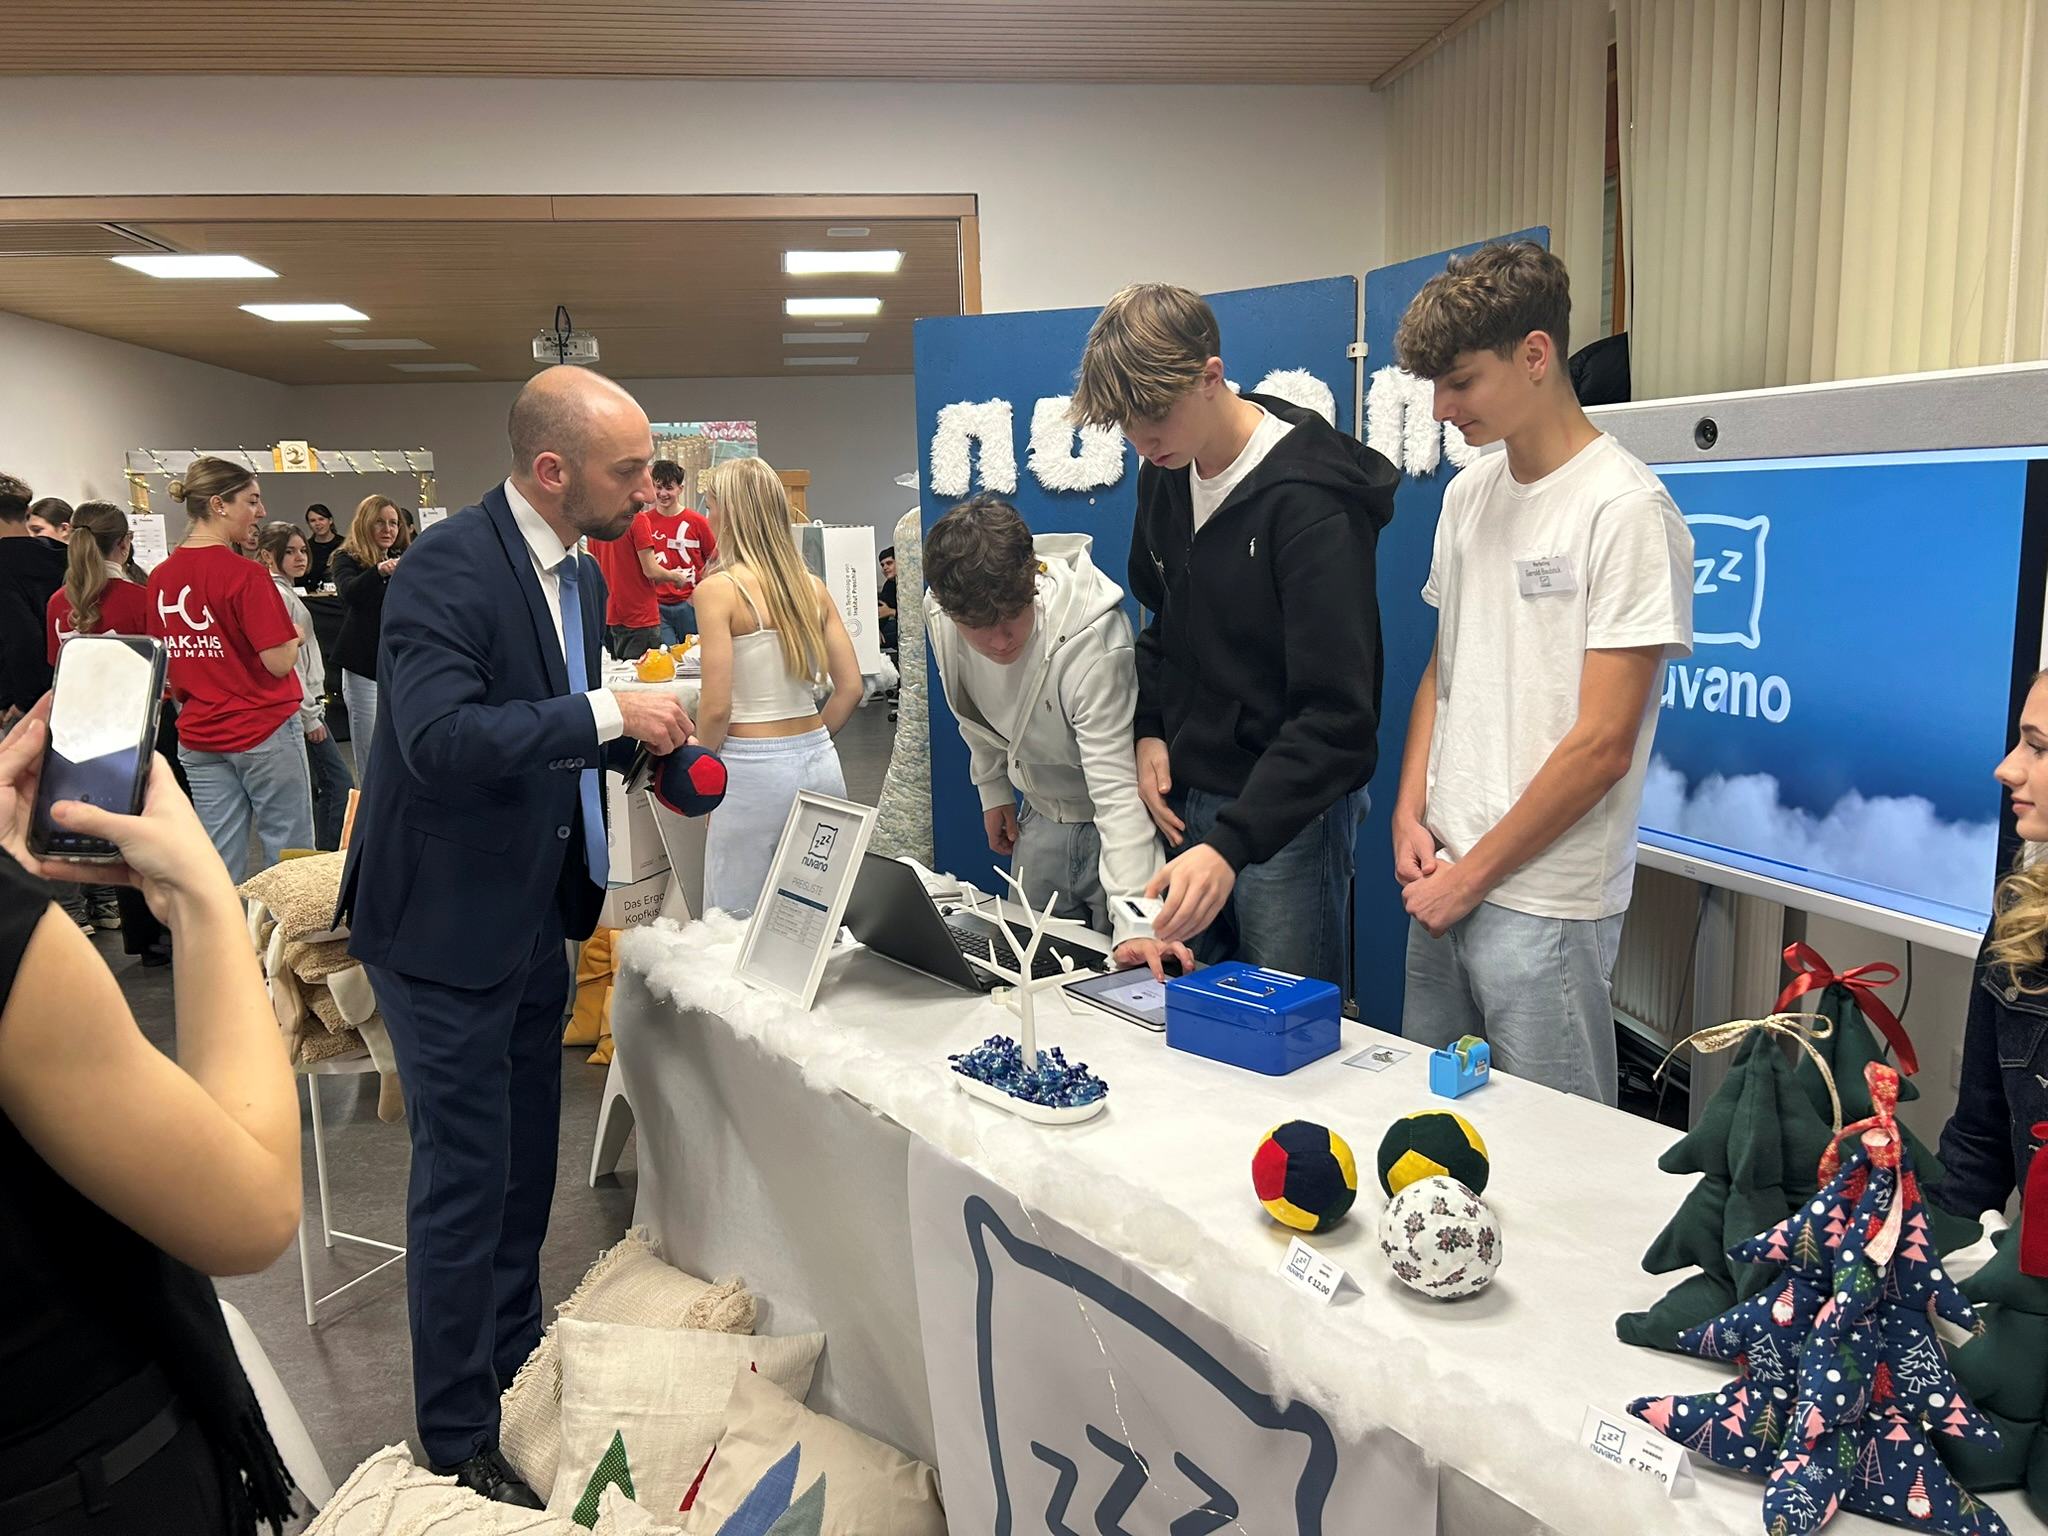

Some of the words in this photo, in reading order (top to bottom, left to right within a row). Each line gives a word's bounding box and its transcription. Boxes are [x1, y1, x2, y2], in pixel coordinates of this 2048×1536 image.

[1660, 664, 1791, 723] uvano
[801, 856, 829, 872] nuvano
[624, 900, 642, 911] Das
[1286, 1265, 1305, 1281] nuvano
[1312, 1279, 1330, 1295] 12,00
[1590, 1443, 1622, 1464] nuvano
[1637, 1461, 1668, 1483] 2500
